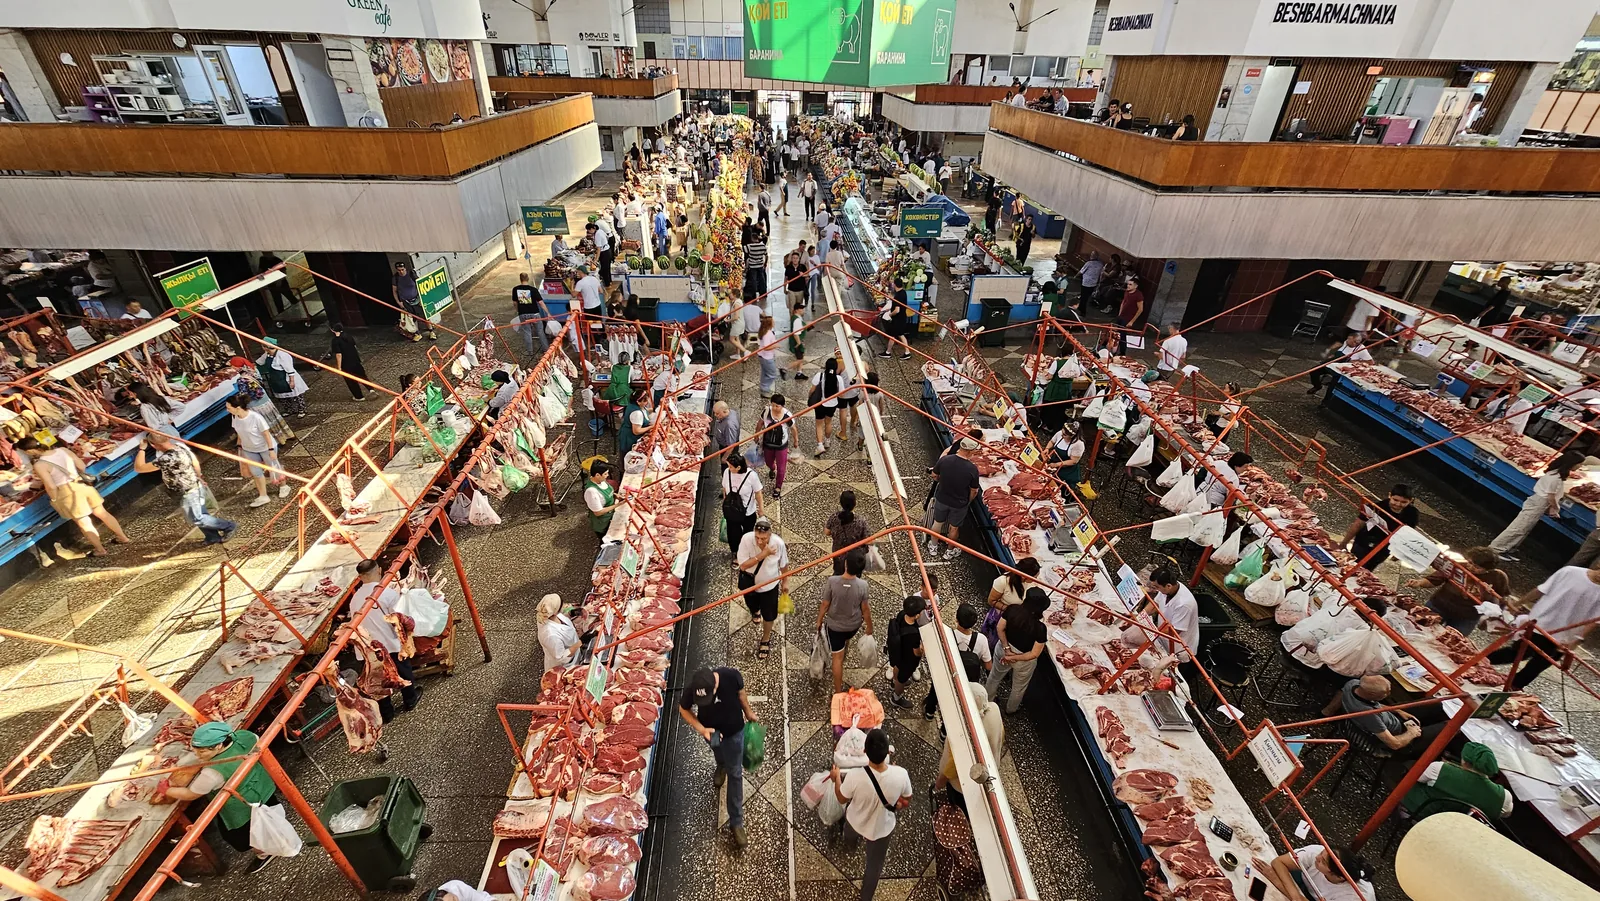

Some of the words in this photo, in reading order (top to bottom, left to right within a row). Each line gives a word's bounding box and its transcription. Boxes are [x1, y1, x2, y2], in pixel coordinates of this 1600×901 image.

[774, 1, 789, 20] ЕТІ
[901, 5, 914, 25] ЕТІ
[1272, 2, 1398, 25] BESHBARMACHNAYA
[1108, 13, 1154, 31] BESHBARMACHNAYA
[749, 50, 784, 61] БАРАНИНА
[876, 52, 906, 64] БАРАНИНА
[419, 275, 436, 295] ҚОЙ
[434, 271, 446, 286] ЕТІ
